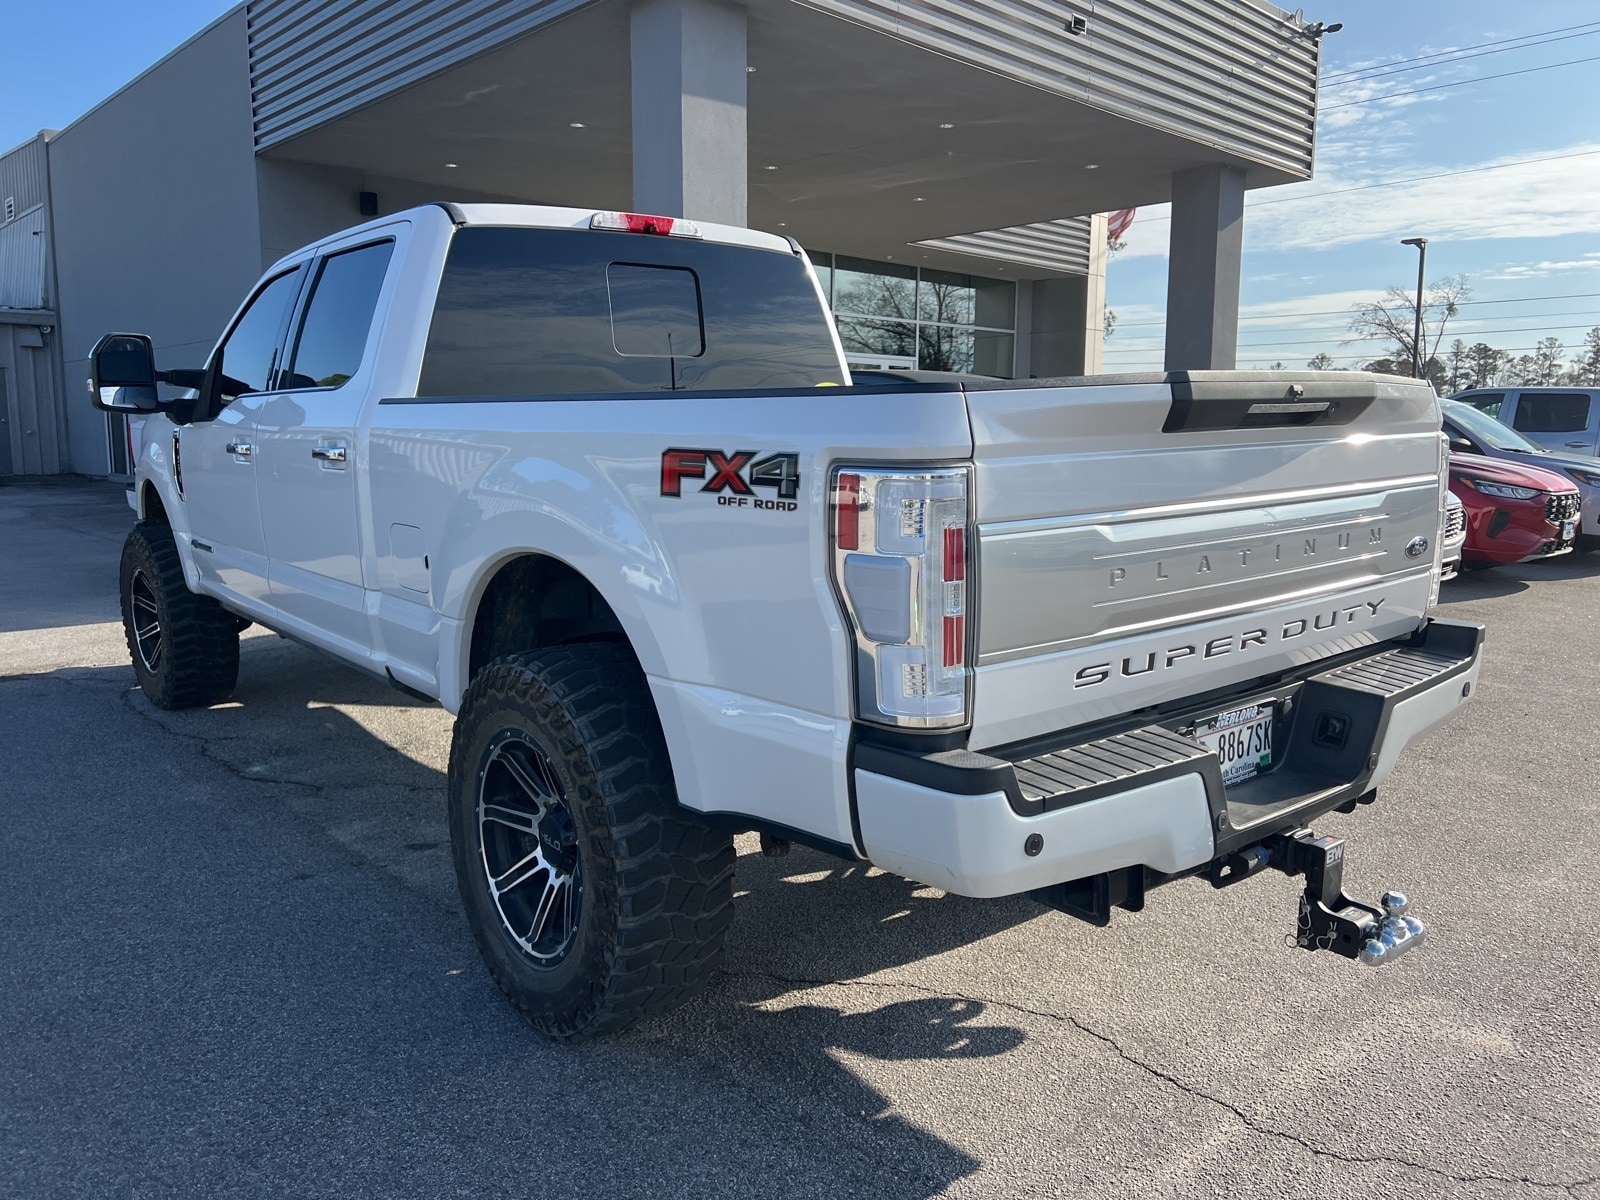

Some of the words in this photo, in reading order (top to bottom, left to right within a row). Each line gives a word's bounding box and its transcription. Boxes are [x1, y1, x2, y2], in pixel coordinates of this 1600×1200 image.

[660, 447, 800, 499] FX4
[717, 496, 748, 508] OFF
[753, 498, 798, 512] ROAD
[1109, 527, 1382, 589] PLATINUM
[1073, 628, 1267, 690] SUPER
[1280, 598, 1386, 641] DUTY
[1230, 761, 1255, 776] Carolina
